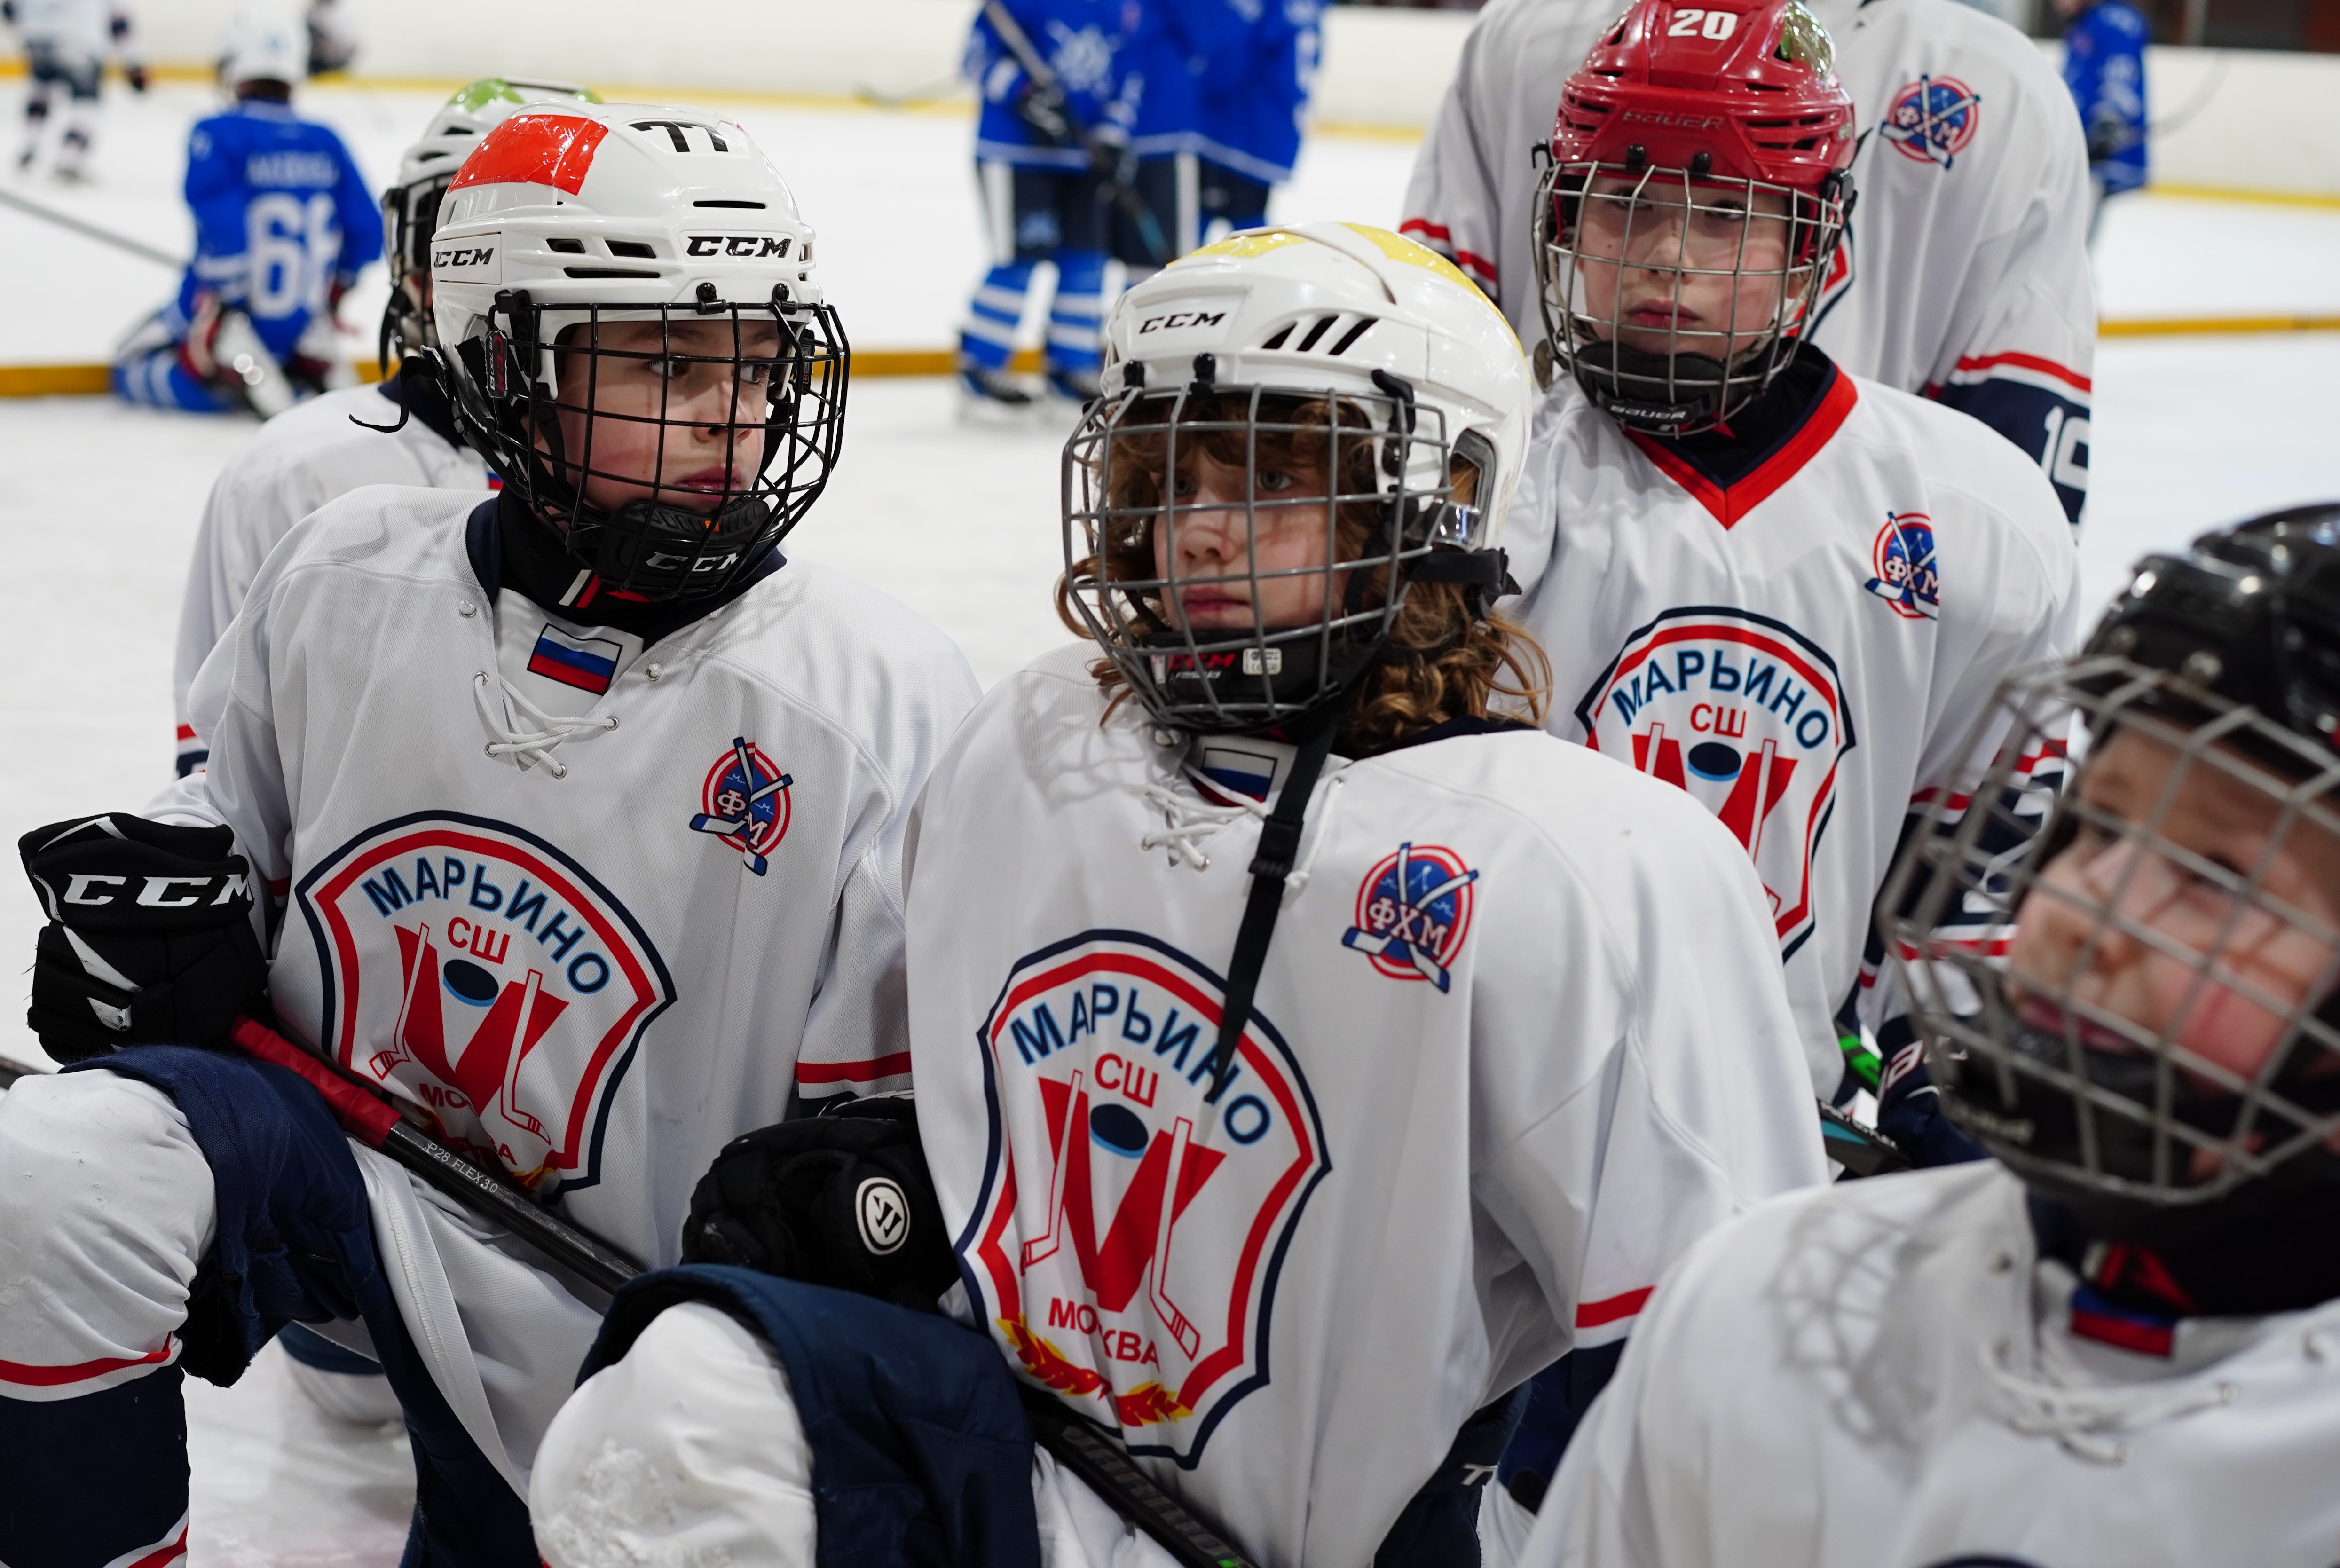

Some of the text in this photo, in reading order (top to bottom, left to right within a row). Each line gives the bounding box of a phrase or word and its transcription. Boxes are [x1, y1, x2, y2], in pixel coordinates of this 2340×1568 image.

[1667, 9, 1738, 41] 20
[1895, 105, 1960, 150] ФХМ
[433, 248, 494, 268] CCM
[686, 236, 792, 258] CCM
[1139, 312, 1226, 334] CCM
[1610, 404, 1687, 420] BAUER
[1611, 649, 1829, 750] МАРЬИНО
[1689, 702, 1747, 739] СШ
[63, 873, 254, 907] CCM
[360, 856, 611, 994] МАРЬИНО
[447, 916, 511, 965] СШ
[1368, 896, 1449, 957] ФХМ
[1008, 983, 1271, 1145] МАРЬИНО
[1094, 1052, 1159, 1108] СШ
[426, 1143, 451, 1163] P28
[1048, 1297, 1161, 1374] МОКВА
